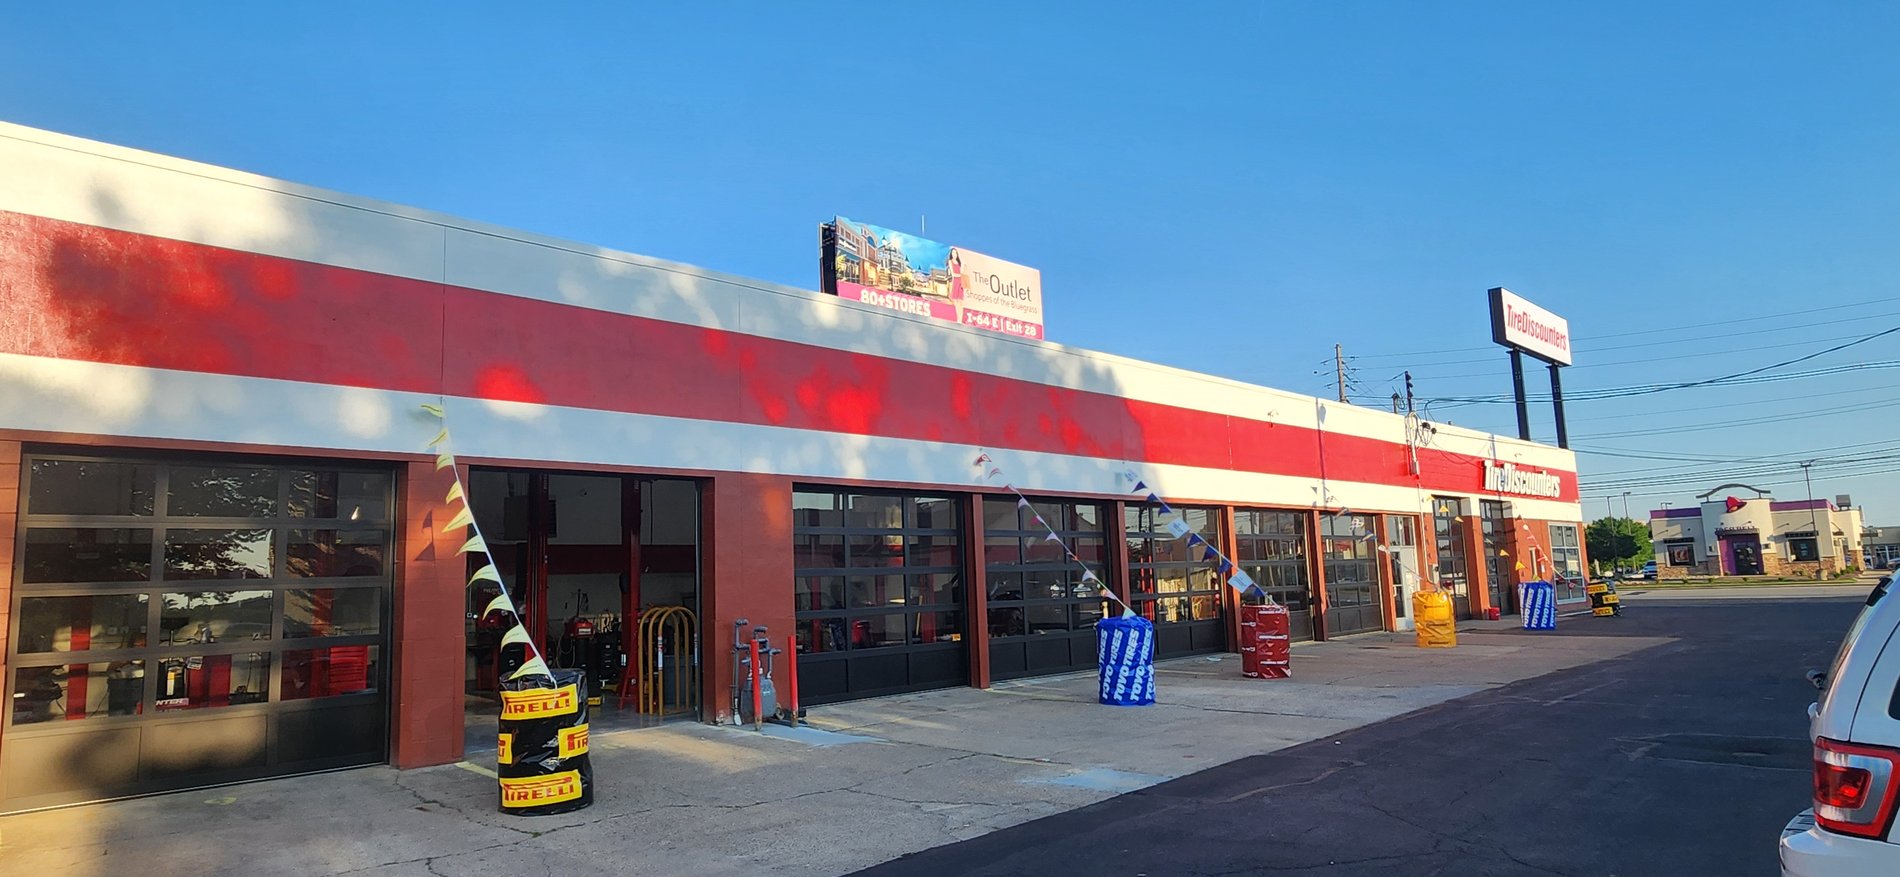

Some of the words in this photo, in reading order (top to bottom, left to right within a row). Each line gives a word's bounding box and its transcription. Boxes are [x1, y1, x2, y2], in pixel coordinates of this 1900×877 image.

[973, 271, 989, 286] The
[989, 274, 1032, 302] Outlet
[966, 312, 990, 326] I-64
[991, 317, 999, 328] E
[1005, 320, 1022, 334] Exit
[1024, 324, 1037, 337] 28
[1507, 304, 1567, 351] TireDiscounters
[1484, 460, 1561, 498] TireDiscounters
[1114, 665, 1129, 701] TOYO
[1123, 628, 1139, 666] TIRES
[1130, 665, 1145, 701] TOYO
[503, 776, 575, 801] PIRELLI
